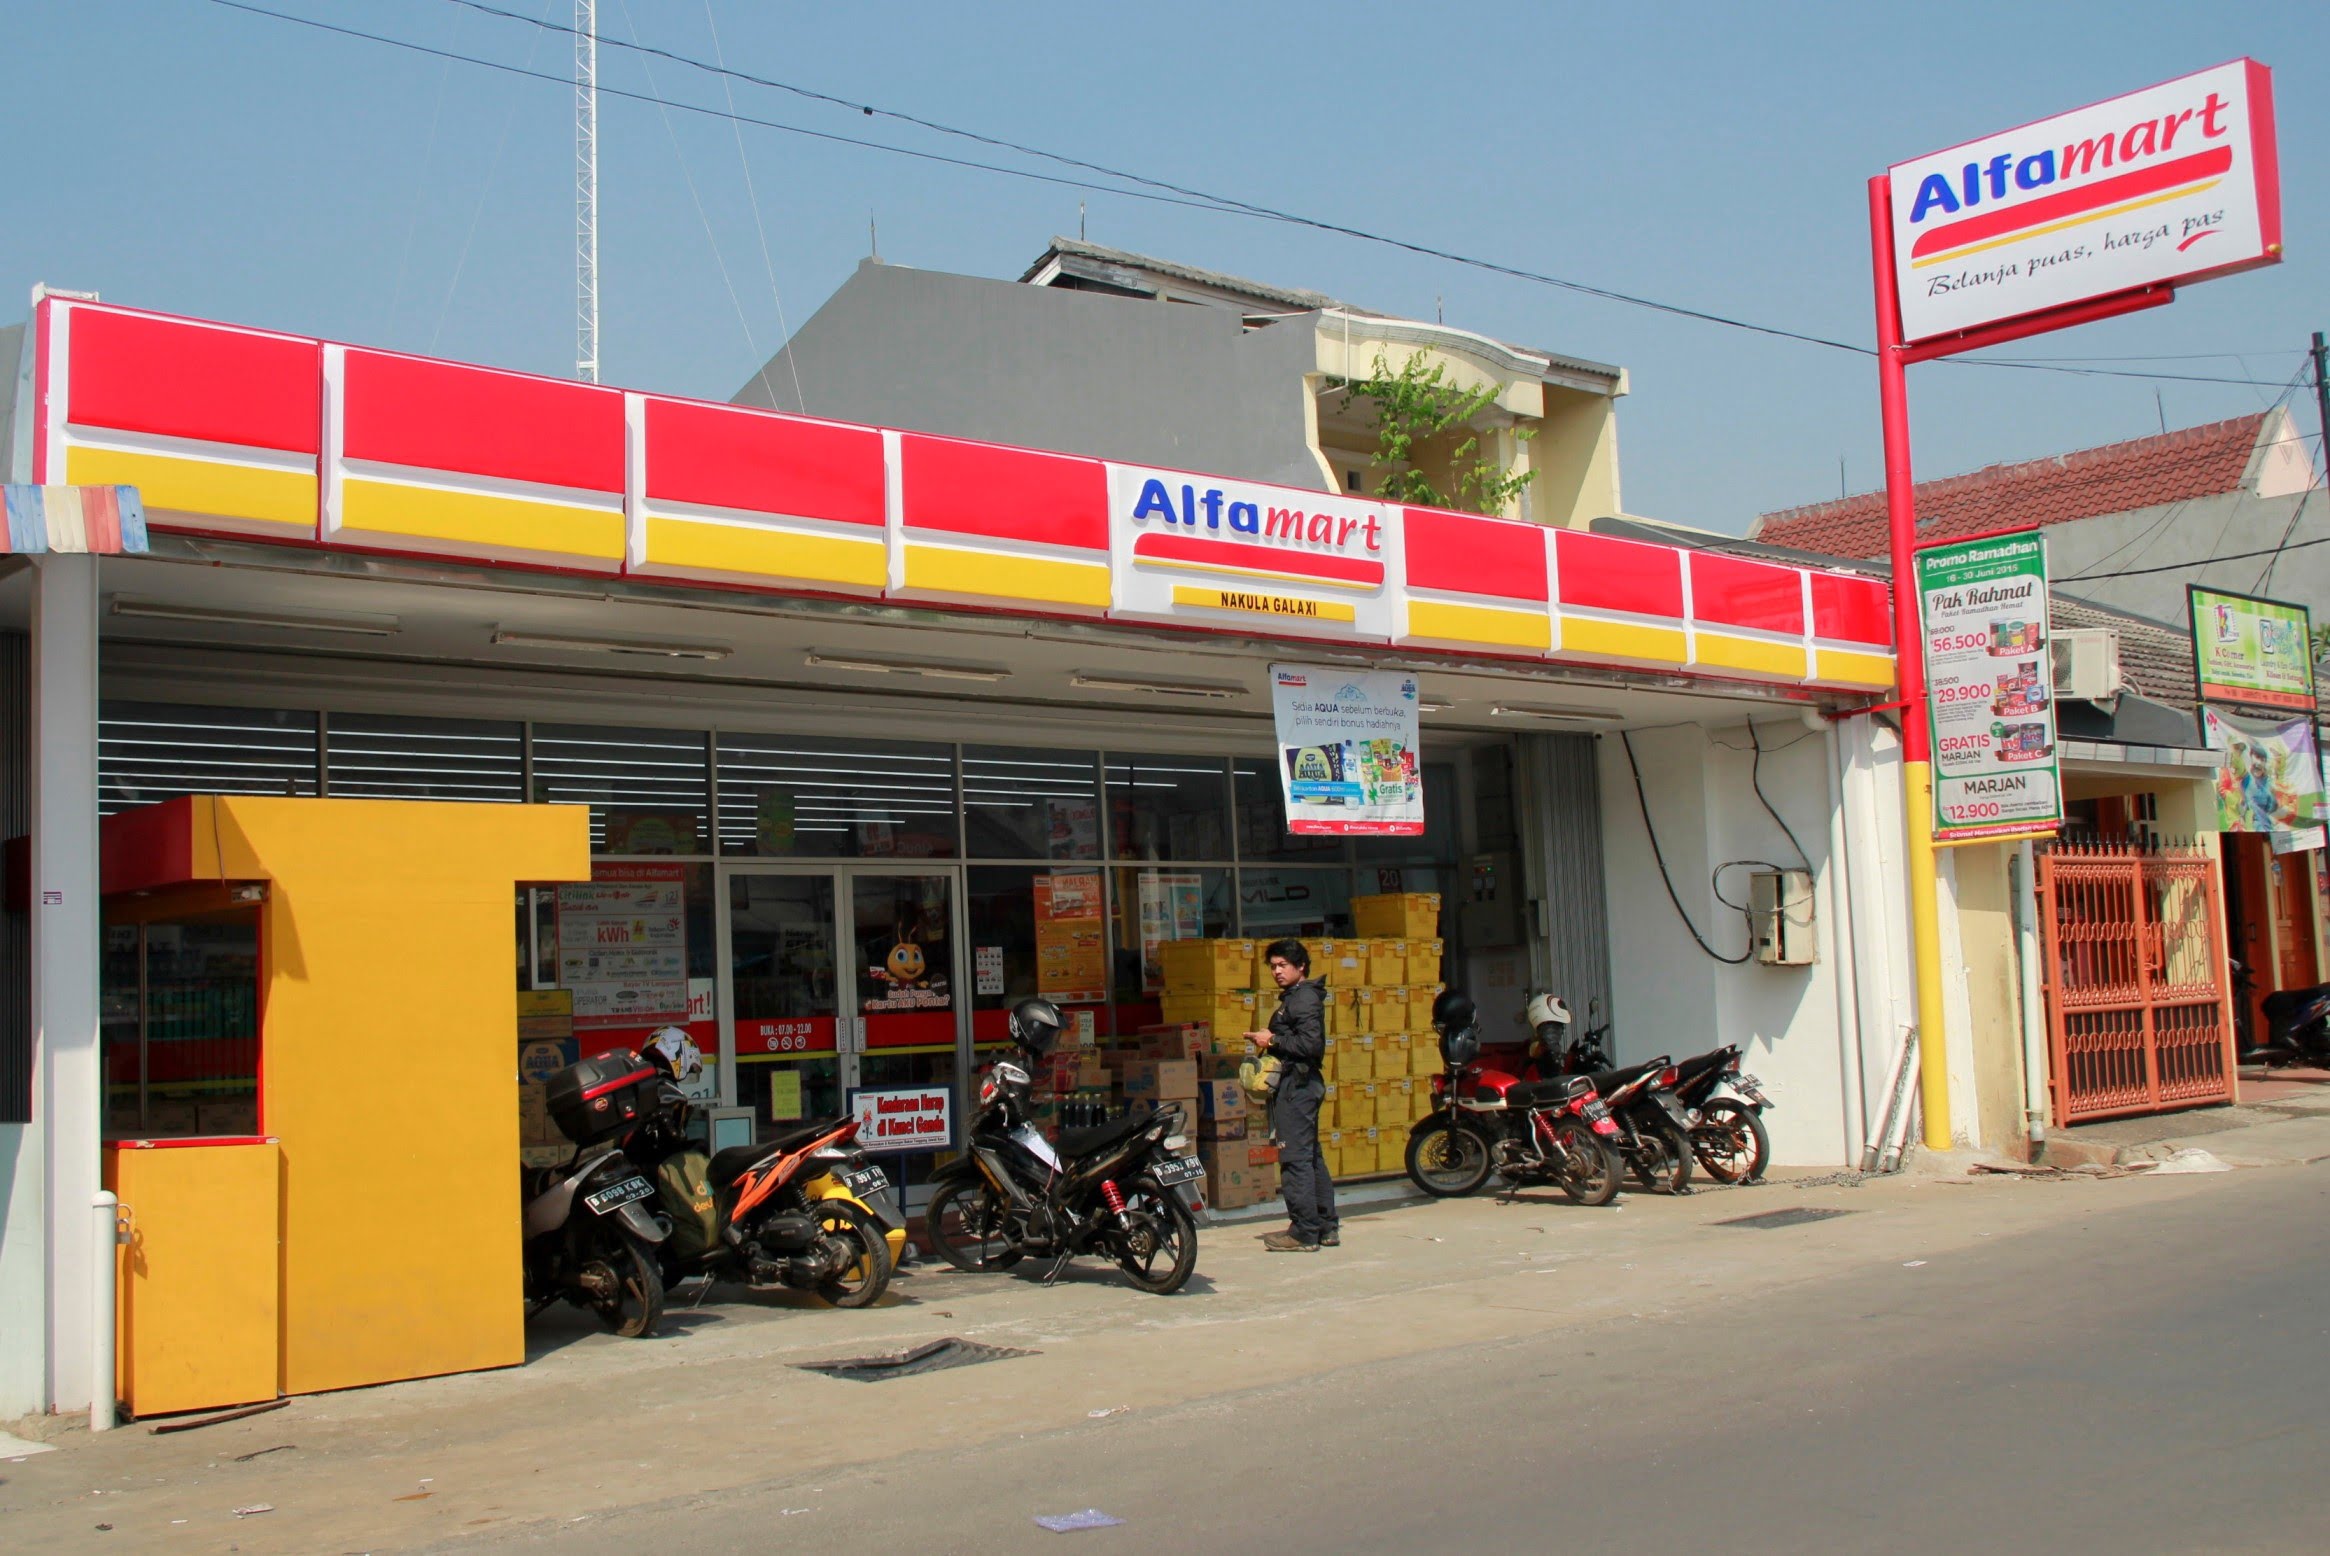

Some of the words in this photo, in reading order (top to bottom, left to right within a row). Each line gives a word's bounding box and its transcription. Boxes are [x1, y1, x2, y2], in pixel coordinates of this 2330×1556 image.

[1909, 92, 2230, 223] Alfamart
[1927, 262, 2018, 297] Belanja
[2027, 245, 2094, 278] puas,
[2104, 223, 2171, 252] harga
[2181, 207, 2226, 239] pas
[1133, 478, 1382, 551] Alfamart
[1926, 553, 1967, 571] Promo
[1969, 541, 2038, 563] Ramadhan
[1975, 568, 1994, 578] Juni
[1996, 563, 2018, 575] 2015
[1933, 592, 1962, 611] Pak
[1966, 582, 2033, 607] Rahmat
[1221, 592, 1269, 612] NAKULA
[1274, 597, 1317, 617] GALAXI
[1933, 632, 1987, 653] 56.500
[2000, 647, 2024, 656] Paket
[2026, 644, 2035, 653] A
[2215, 646, 2221, 657] K
[2222, 648, 2245, 660] Corner
[1278, 672, 1307, 682] Alfamart
[1938, 683, 1990, 704] 29.900
[1291, 701, 1313, 711] Sedia
[1314, 702, 1339, 713] AQUA
[1341, 705, 1372, 715] sebelum
[1374, 706, 1406, 718] berbuka,
[2004, 706, 2028, 716] Paket
[2031, 704, 2038, 713] B
[1295, 717, 1313, 727] pilih
[1315, 718, 1339, 727] sendiri
[1341, 719, 1364, 728] bonus
[1938, 734, 1990, 751] GRATIS
[1942, 750, 1981, 762] MARJAN
[2008, 750, 2032, 760] Paket
[2033, 749, 2043, 758] C
[1379, 783, 1403, 795] Gratis
[1964, 776, 2026, 795] MARJAN
[1949, 802, 2000, 820] 12.900
[618, 867, 634, 877] bisa
[636, 867, 644, 877] di
[1380, 870, 1398, 886] 20
[597, 926, 630, 943] kWh
[888, 989, 909, 999] Sudah
[910, 989, 933, 998] Punya
[872, 1000, 897, 1010] Kartu
[898, 998, 916, 1008] AKU
[760, 1024, 775, 1036] BUKA
[778, 1023, 793, 1036] 07.00
[797, 1022, 812, 1035] 22.00
[877, 1096, 920, 1114] Kendaraan
[921, 1093, 944, 1114] Harap
[877, 1118, 887, 1137] di
[888, 1116, 914, 1136] Kunci
[916, 1115, 945, 1134] Ganda
[1155, 1167, 1163, 1176] B
[845, 1177, 853, 1188] B
[590, 1197, 600, 1207] B
